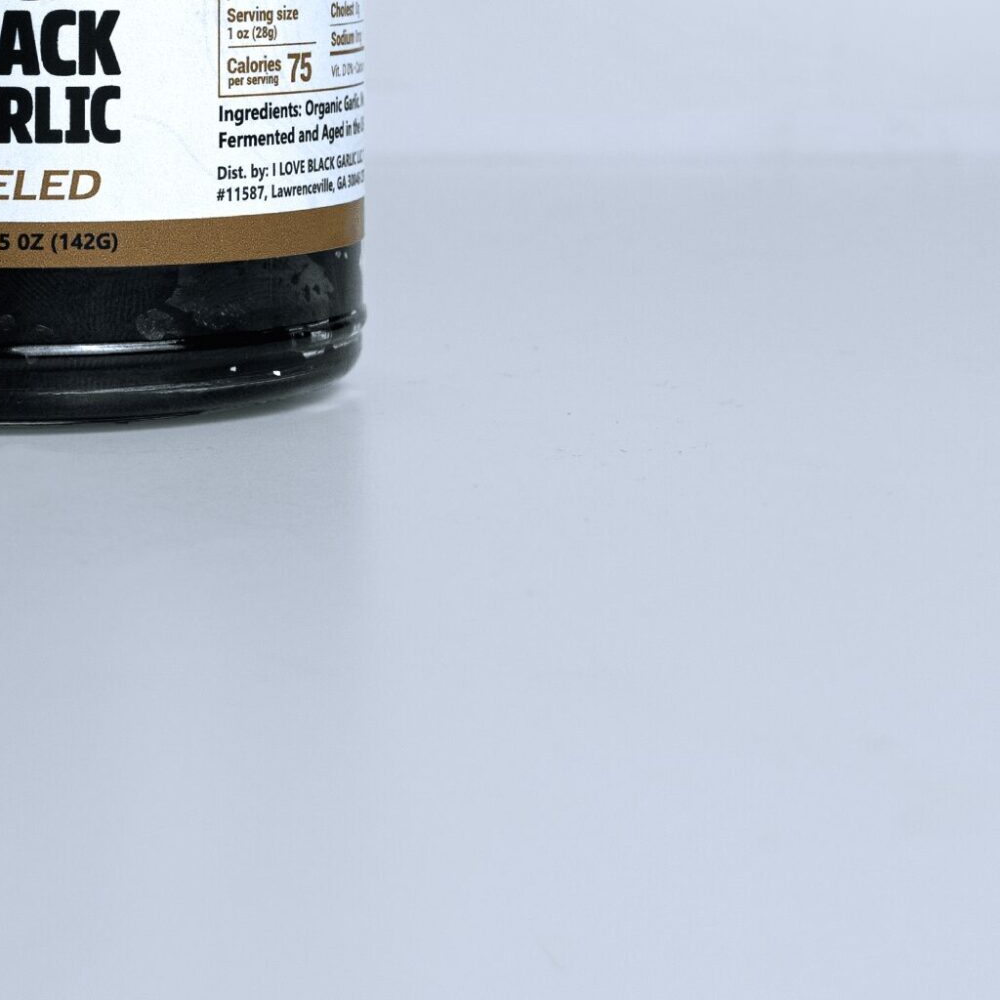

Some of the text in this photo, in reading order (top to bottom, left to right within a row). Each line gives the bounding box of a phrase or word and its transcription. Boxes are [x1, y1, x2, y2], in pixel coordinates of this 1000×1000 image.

[227, 5, 299, 25] Serving size
[228, 25, 278, 42] 1 oz (28g)
[331, 30, 354, 47] Sodium
[227, 52, 312, 83] Calories 75
[228, 73, 279, 89] per serving
[218, 101, 302, 127] Ingredients:
[305, 96, 342, 120] Organic
[344, 93, 361, 112] Garlic
[218, 127, 295, 149] Fermented
[298, 124, 319, 143] and
[321, 121, 344, 144] Aged
[345, 120, 353, 135] in
[217, 165, 246, 181] Dist.
[250, 164, 269, 182] by:
[272, 163, 276, 177] I
[279, 160, 305, 176] LOVE
[307, 156, 335, 174] BLACK
[336, 151, 357, 168] GARLIC
[216, 185, 268, 203] #11587,
[271, 177, 336, 200] Lawrenceville,
[337, 174, 347, 190] GA
[0, 232, 11, 251] 5
[17, 233, 45, 251] OZ
[51, 230, 119, 254] (142G)
